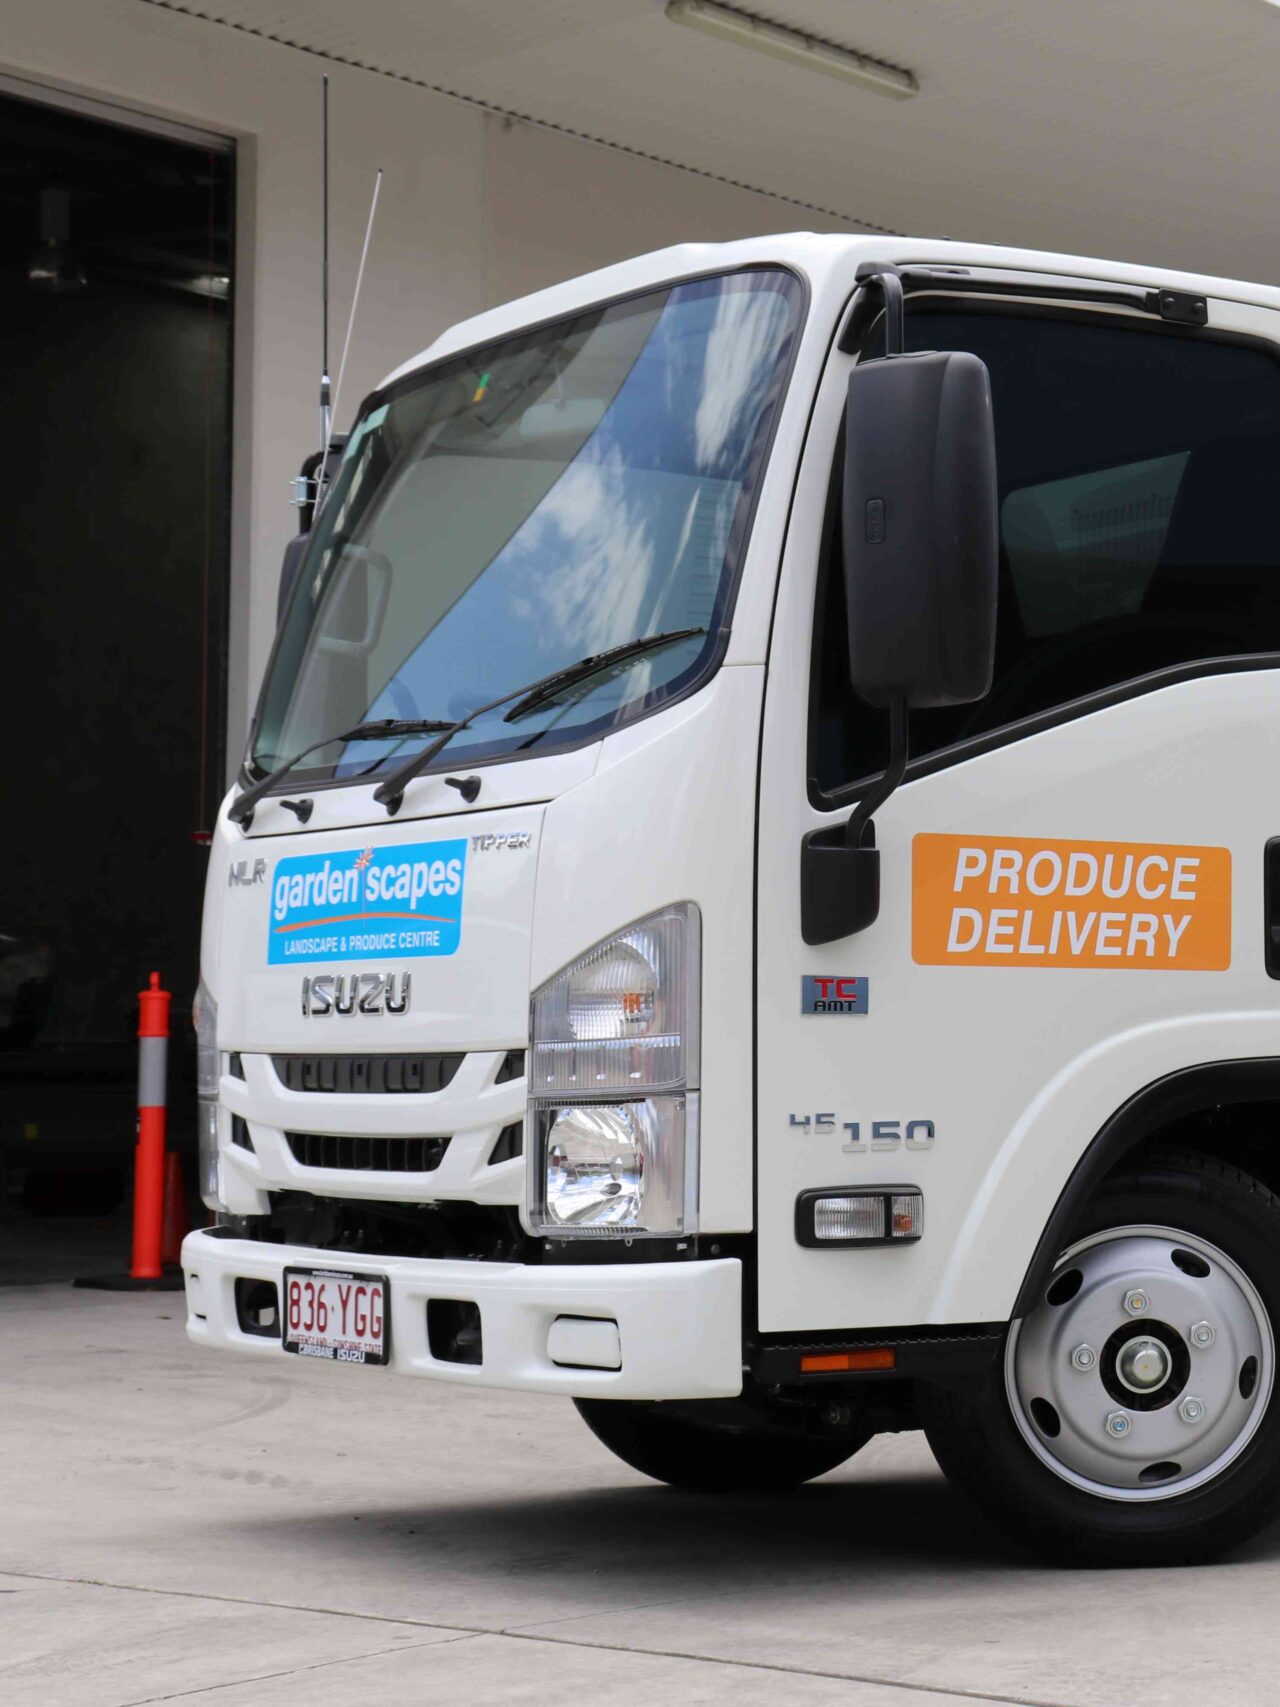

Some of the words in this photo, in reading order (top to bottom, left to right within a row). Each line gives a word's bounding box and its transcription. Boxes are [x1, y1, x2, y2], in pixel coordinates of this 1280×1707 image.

[472, 831, 531, 851] TIPPER
[228, 858, 268, 887] NLR
[274, 861, 359, 921] garden
[365, 858, 461, 909] scapes
[953, 848, 1200, 900] PRODUCE
[285, 936, 337, 955] LANDSCAPE
[341, 938, 346, 952] &
[350, 933, 396, 951] PRODUCE
[399, 930, 440, 947] CENTRE
[947, 908, 1191, 957] DELIVERY
[301, 971, 413, 1017] ISUZU
[814, 977, 857, 999] TC
[814, 1000, 856, 1012] AMT
[789, 1112, 836, 1135] 45
[842, 1119, 935, 1153] 150
